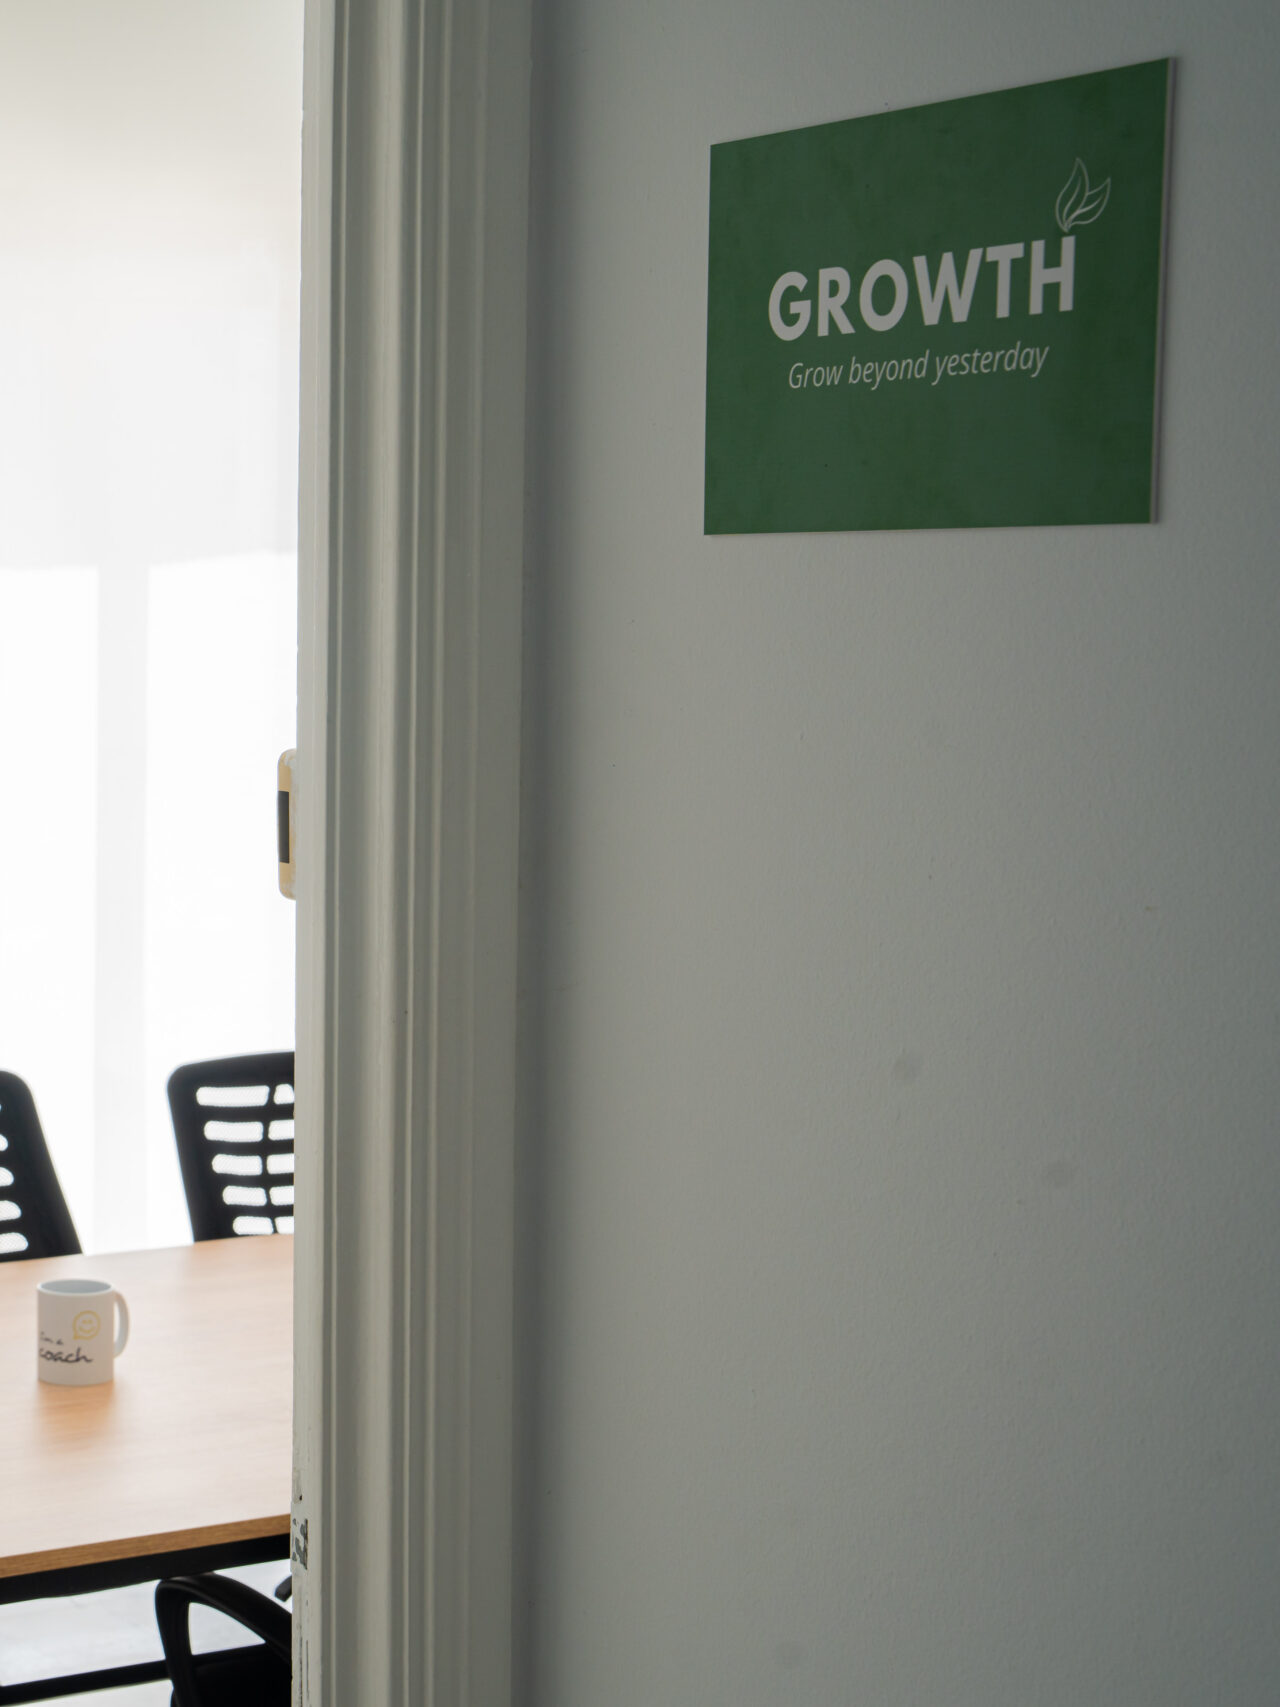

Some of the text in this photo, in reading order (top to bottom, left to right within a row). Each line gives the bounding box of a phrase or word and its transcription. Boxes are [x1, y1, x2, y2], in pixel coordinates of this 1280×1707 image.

[767, 235, 1077, 342] GROWTH
[787, 341, 1050, 391] Grow beyond yesterday
[40, 1347, 93, 1363] coach
